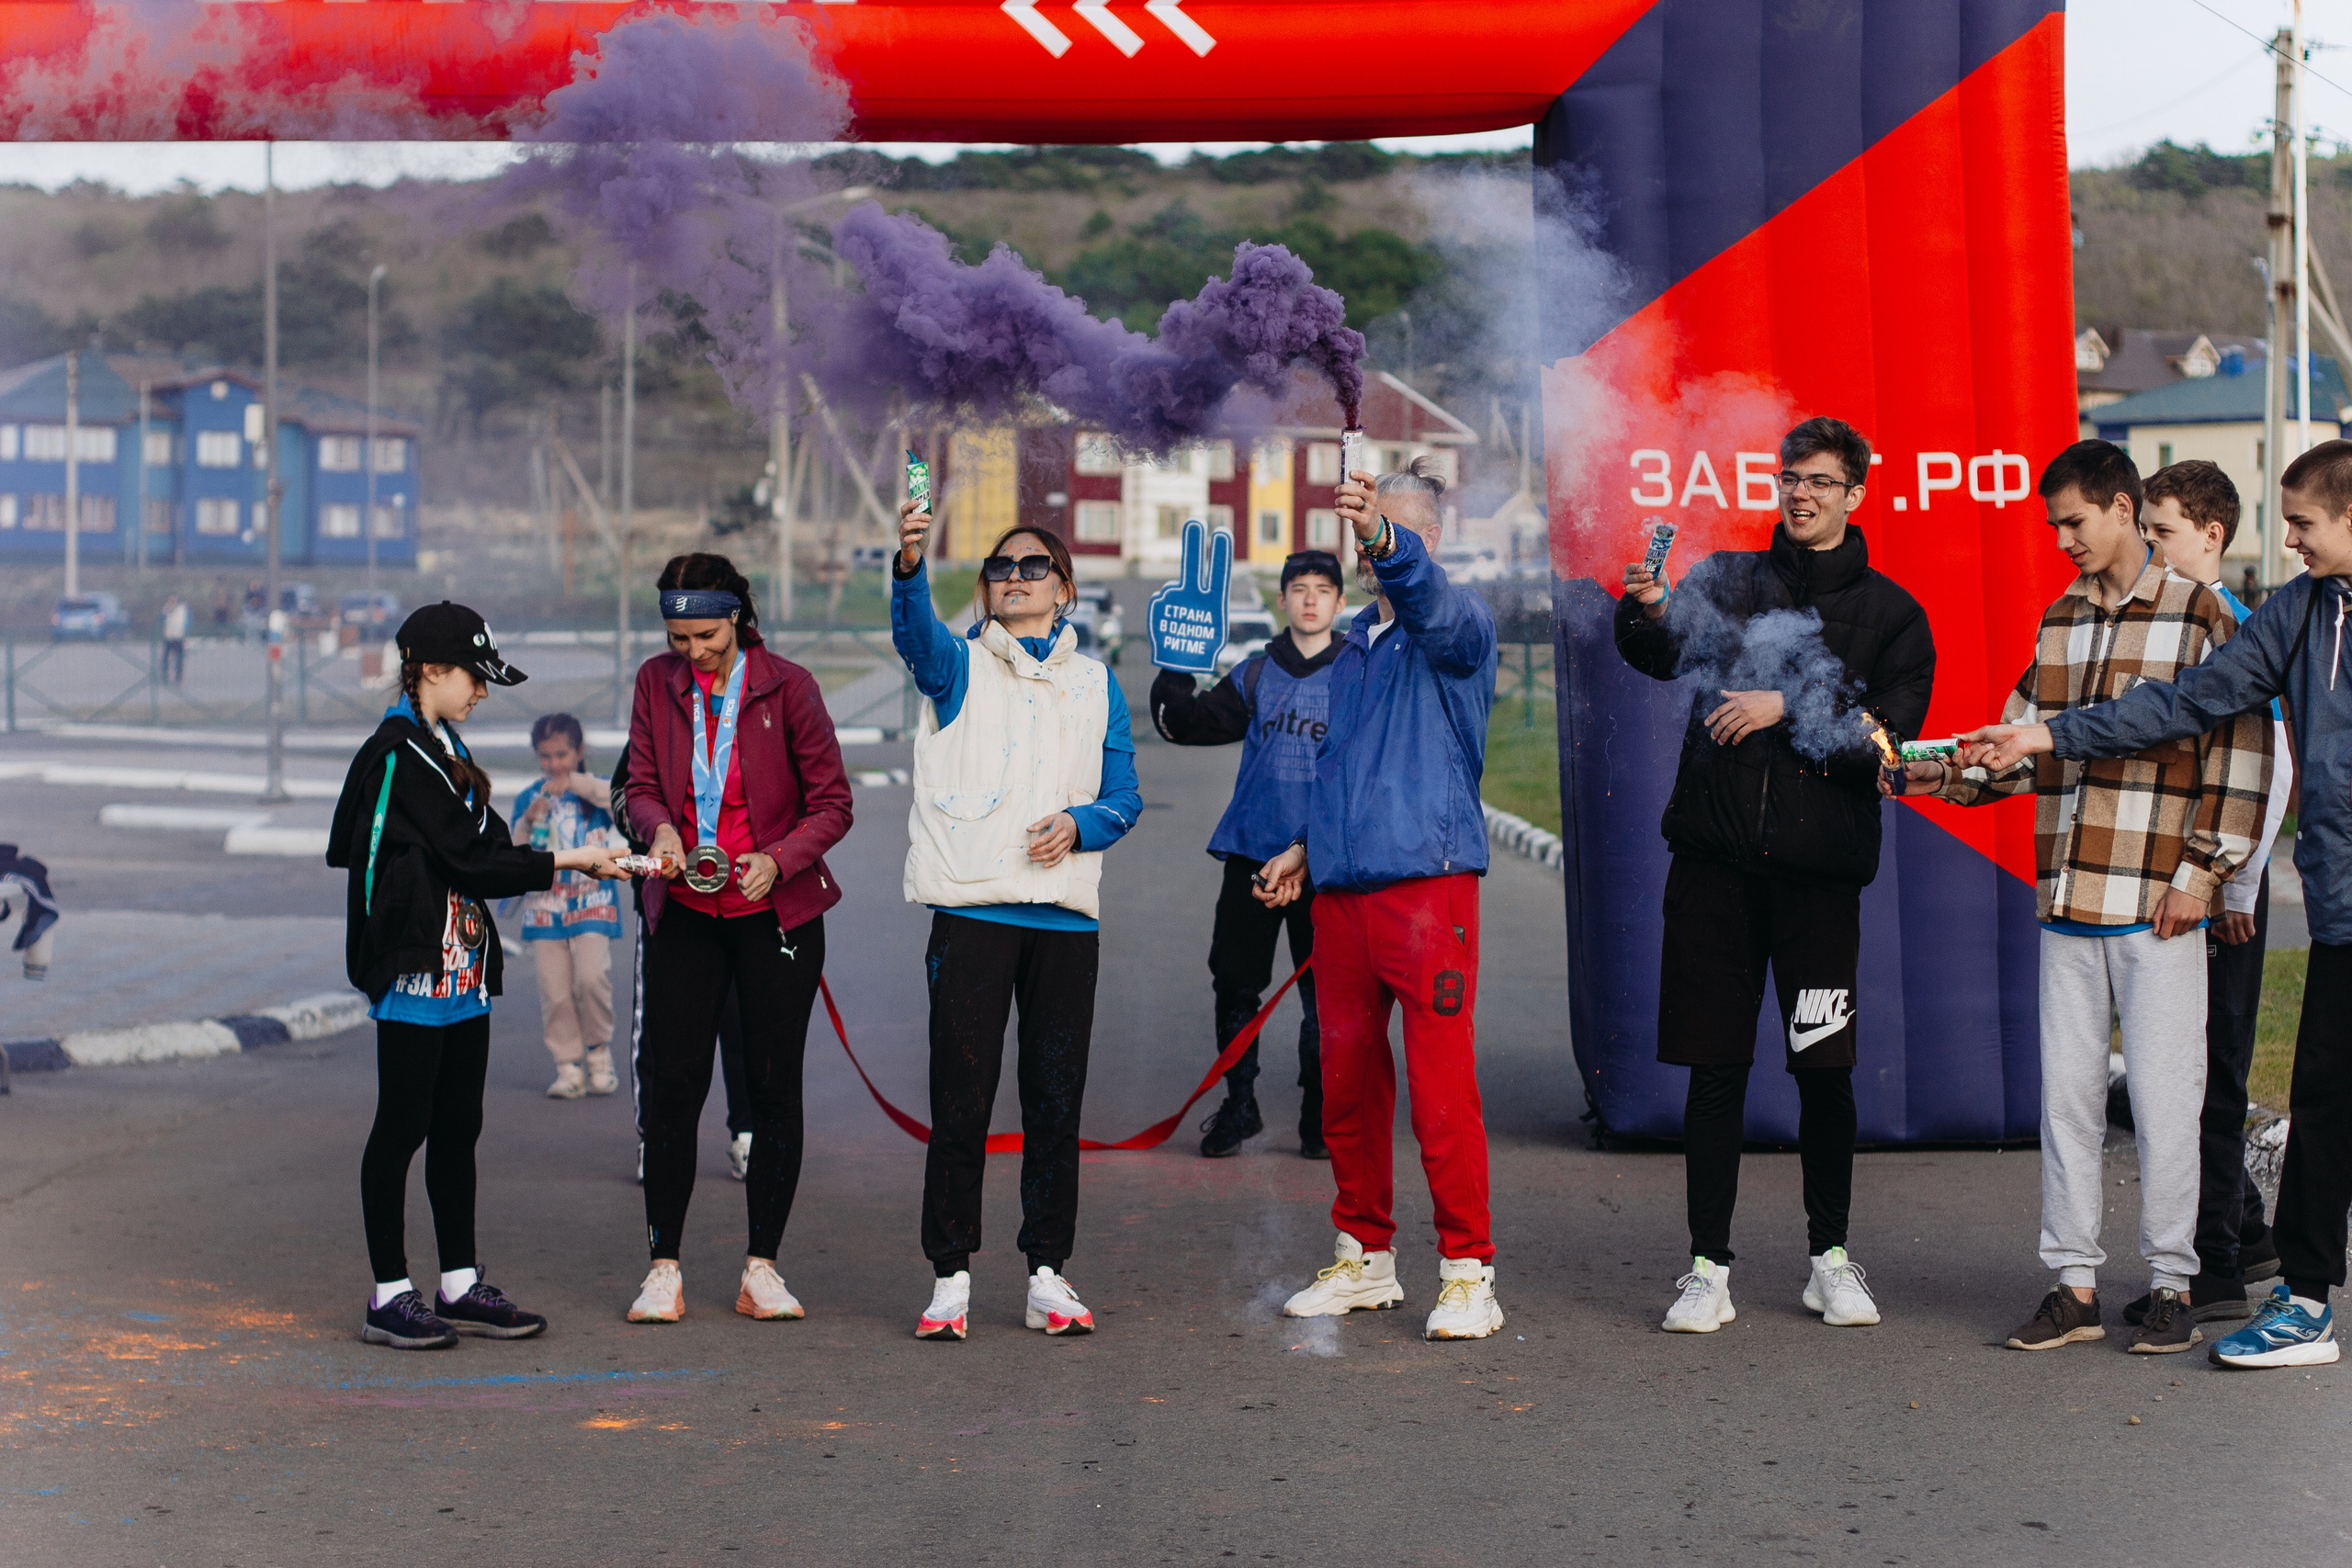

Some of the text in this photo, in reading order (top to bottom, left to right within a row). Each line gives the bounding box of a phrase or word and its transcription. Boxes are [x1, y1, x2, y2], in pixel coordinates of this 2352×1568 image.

[1629, 447, 2030, 512] ЗАБ.РФ
[1164, 604, 1213, 625] СТРАНА
[1159, 618, 1216, 640] В ОДНОМ
[1163, 635, 1206, 655] РИТМЕ
[725, 698, 736, 716] ПСБ
[1432, 969, 1465, 1017] 8
[1793, 988, 1849, 1024] NIKE
